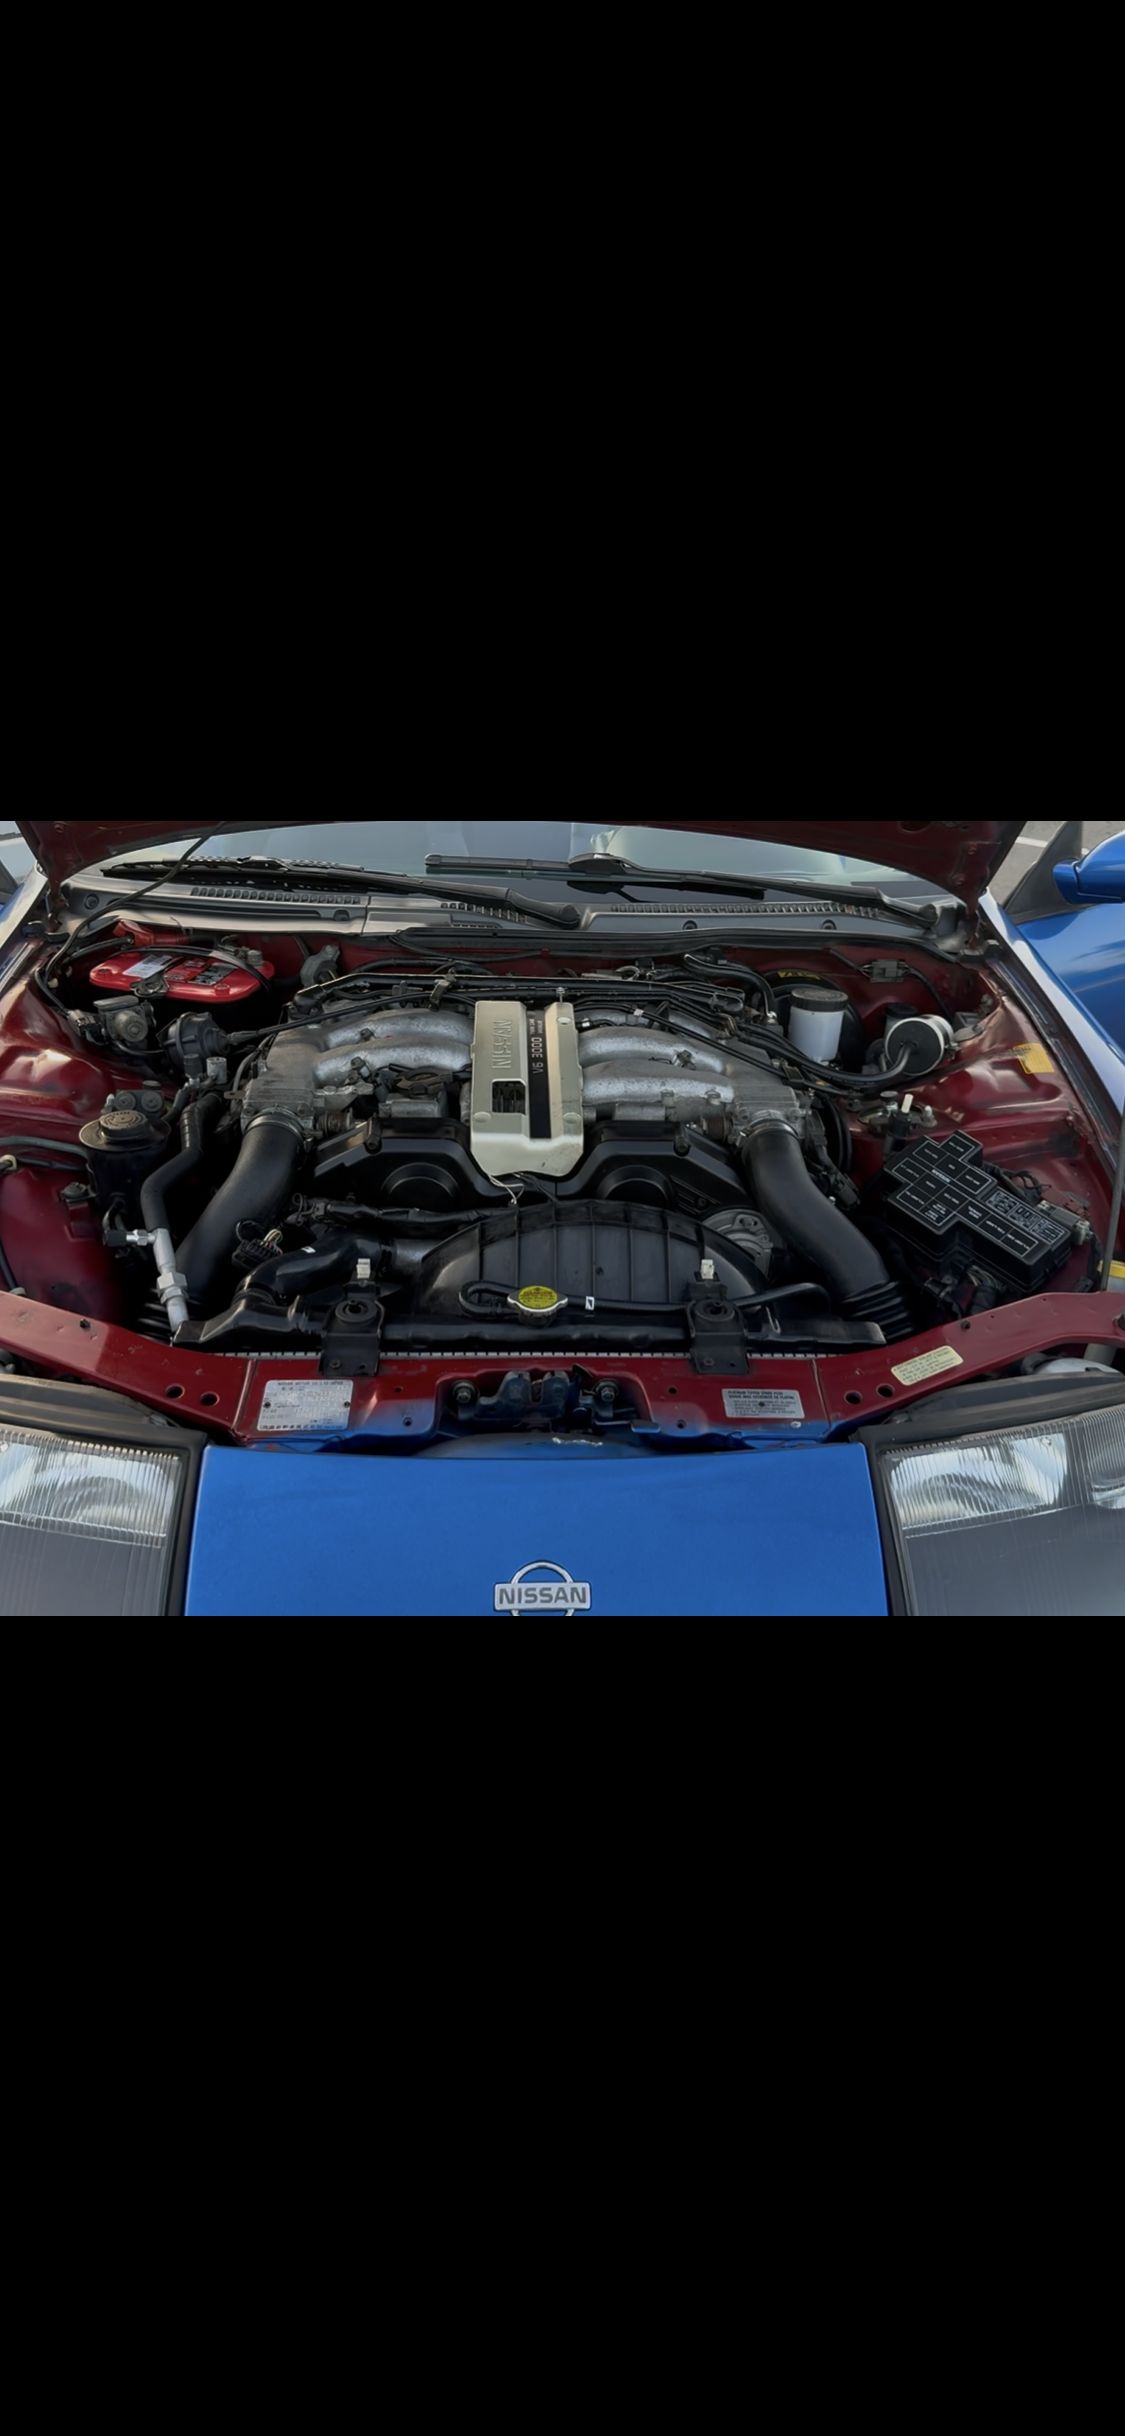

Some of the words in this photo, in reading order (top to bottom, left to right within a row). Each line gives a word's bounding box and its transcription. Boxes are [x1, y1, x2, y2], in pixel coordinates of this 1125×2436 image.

[491, 1020, 512, 1069] NISSAN
[531, 1037, 543, 1058] 3000
[532, 1062, 544, 1074] V6
[499, 1587, 586, 1605] NISSAN
